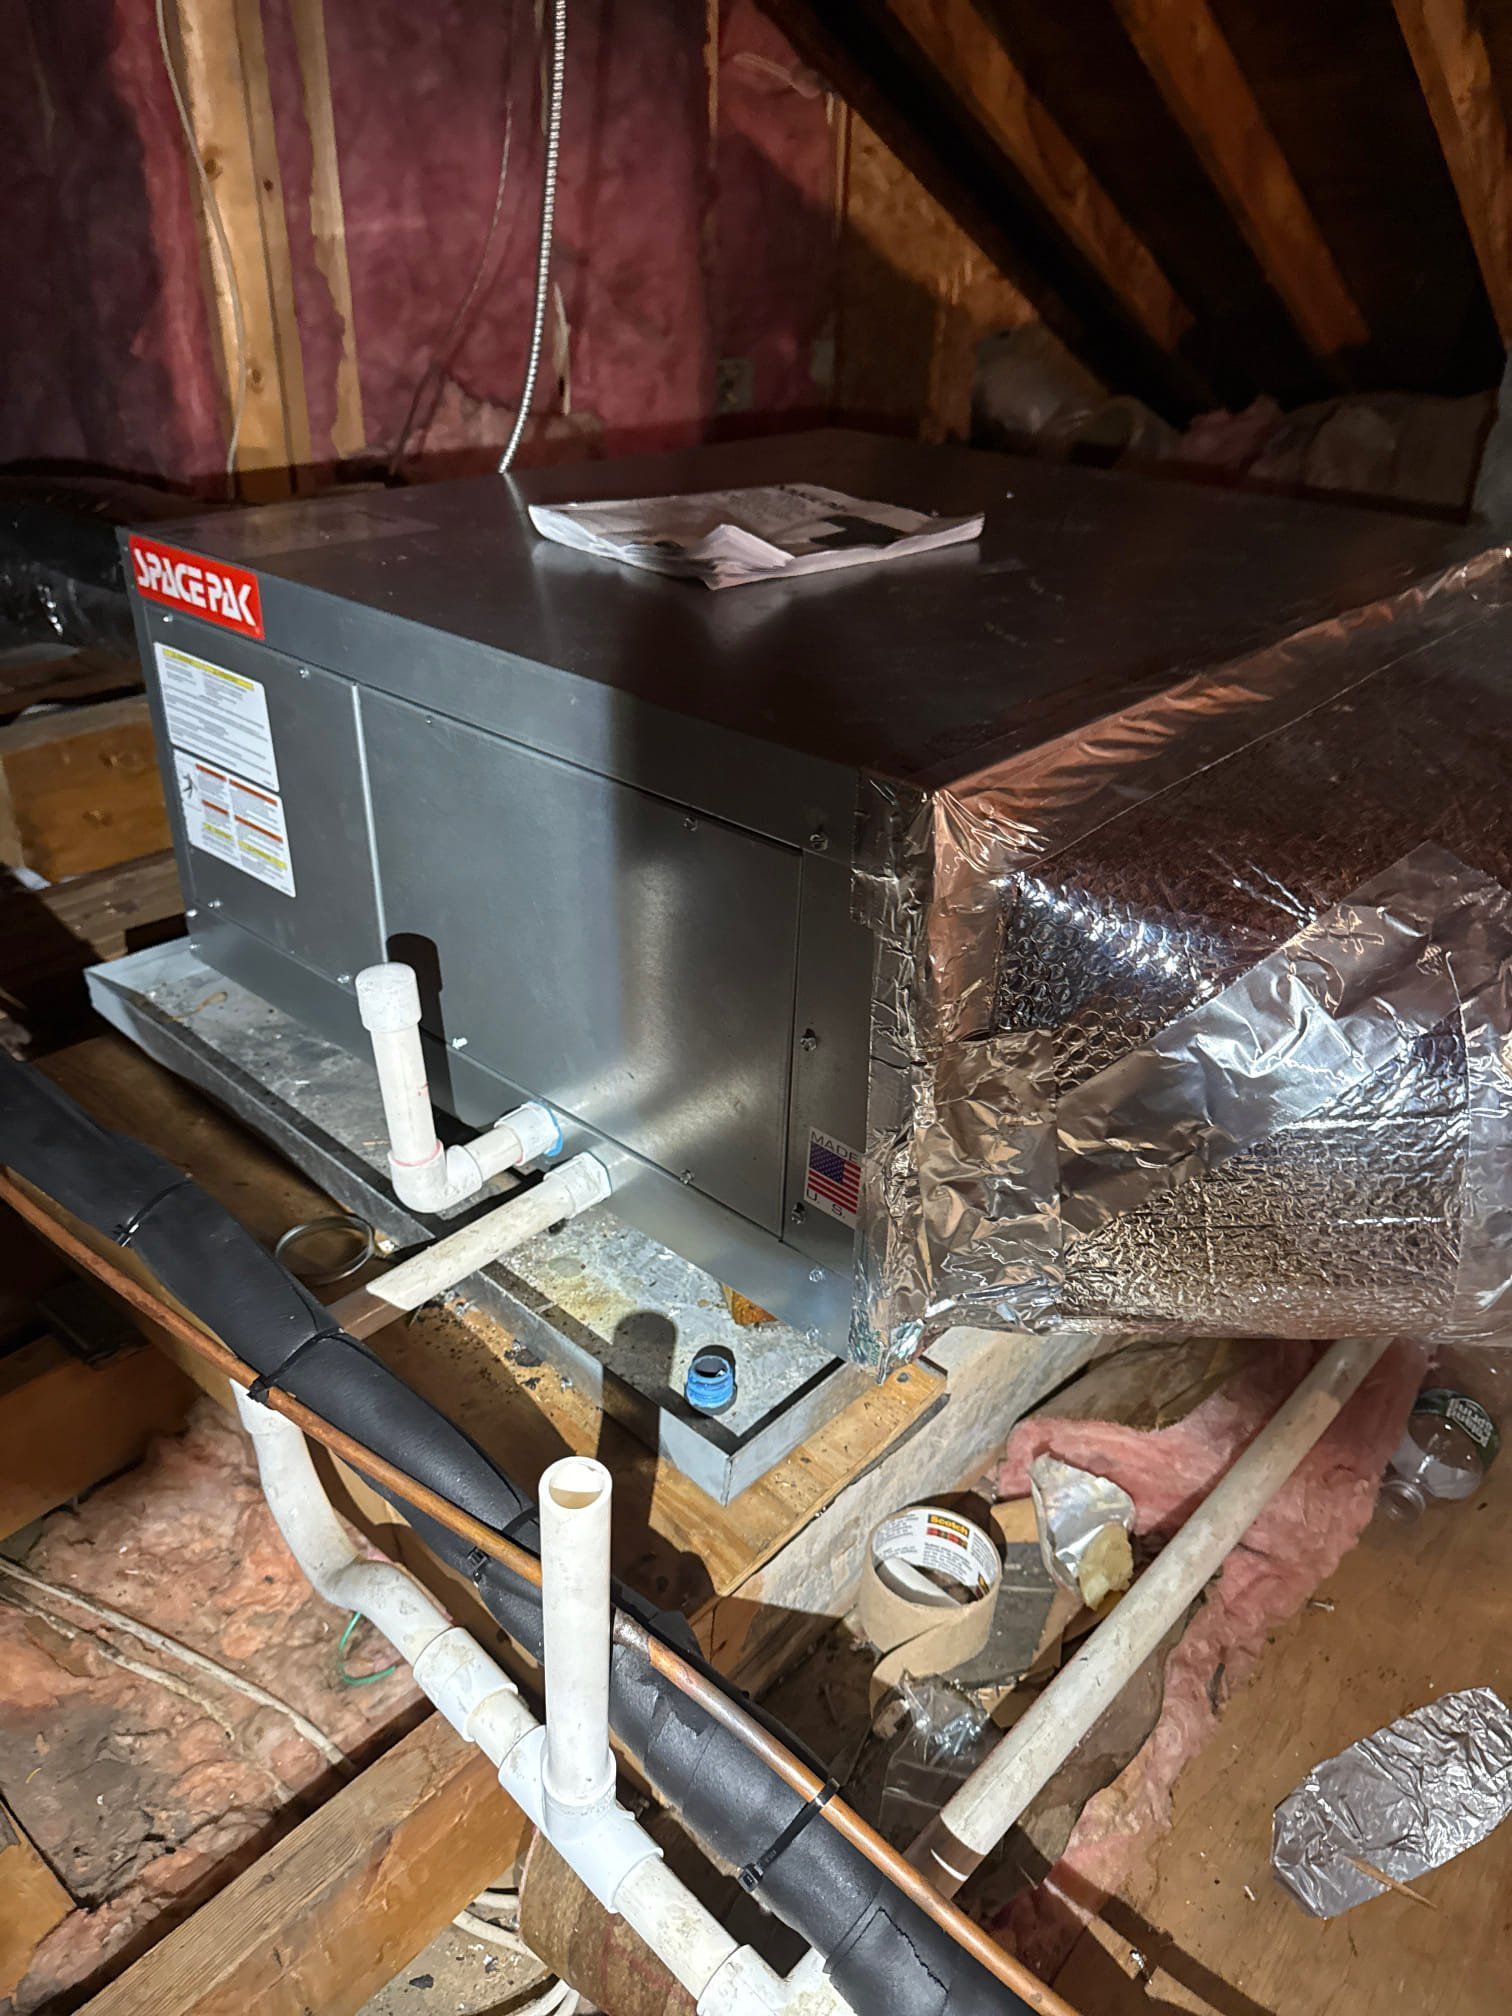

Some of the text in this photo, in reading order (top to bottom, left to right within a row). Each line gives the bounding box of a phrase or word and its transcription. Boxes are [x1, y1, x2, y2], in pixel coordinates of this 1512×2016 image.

[134, 548, 256, 627] SPACEPAK
[811, 1131, 858, 1161] MADE
[930, 1515, 968, 1536] Scotch
